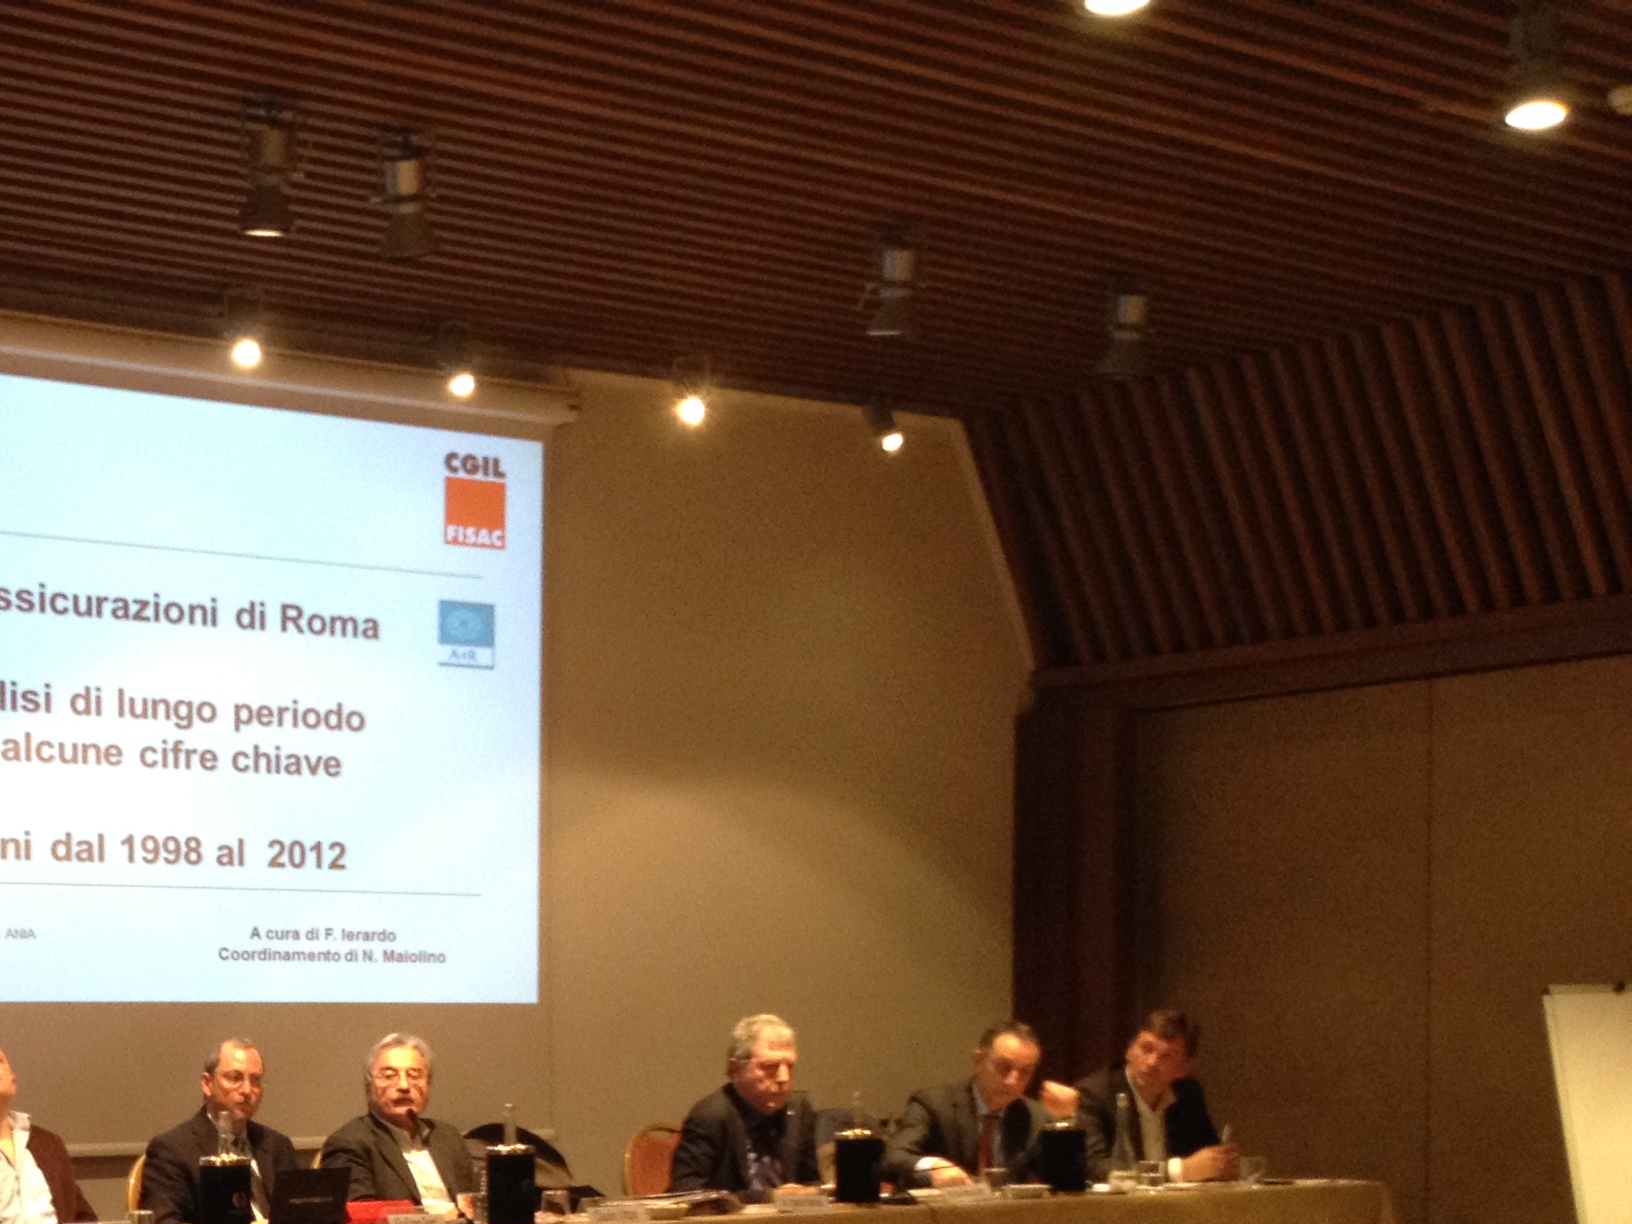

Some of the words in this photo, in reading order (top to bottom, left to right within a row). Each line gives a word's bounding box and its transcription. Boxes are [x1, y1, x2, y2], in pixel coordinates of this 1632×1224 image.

[445, 452, 506, 478] CGIL
[446, 525, 504, 547] FISAC
[235, 601, 266, 631] di
[279, 603, 381, 640] Roma
[69, 686, 102, 716] di
[117, 688, 217, 730] lungo
[233, 700, 366, 732] periodo
[0, 732, 123, 766] alcune
[139, 739, 218, 771] cifre
[231, 744, 342, 777] chiave
[50, 834, 105, 863] dal
[121, 835, 202, 866] 1998
[216, 838, 244, 868] al
[268, 839, 347, 870] 2012
[250, 926, 261, 940] A
[266, 928, 300, 941] cura
[306, 928, 319, 941] di
[325, 928, 337, 941] F.
[342, 929, 397, 942] Ierardo
[218, 947, 341, 963] Coordinamento
[344, 949, 358, 963] di
[362, 950, 377, 963] N.
[383, 950, 447, 964] Maiolino
